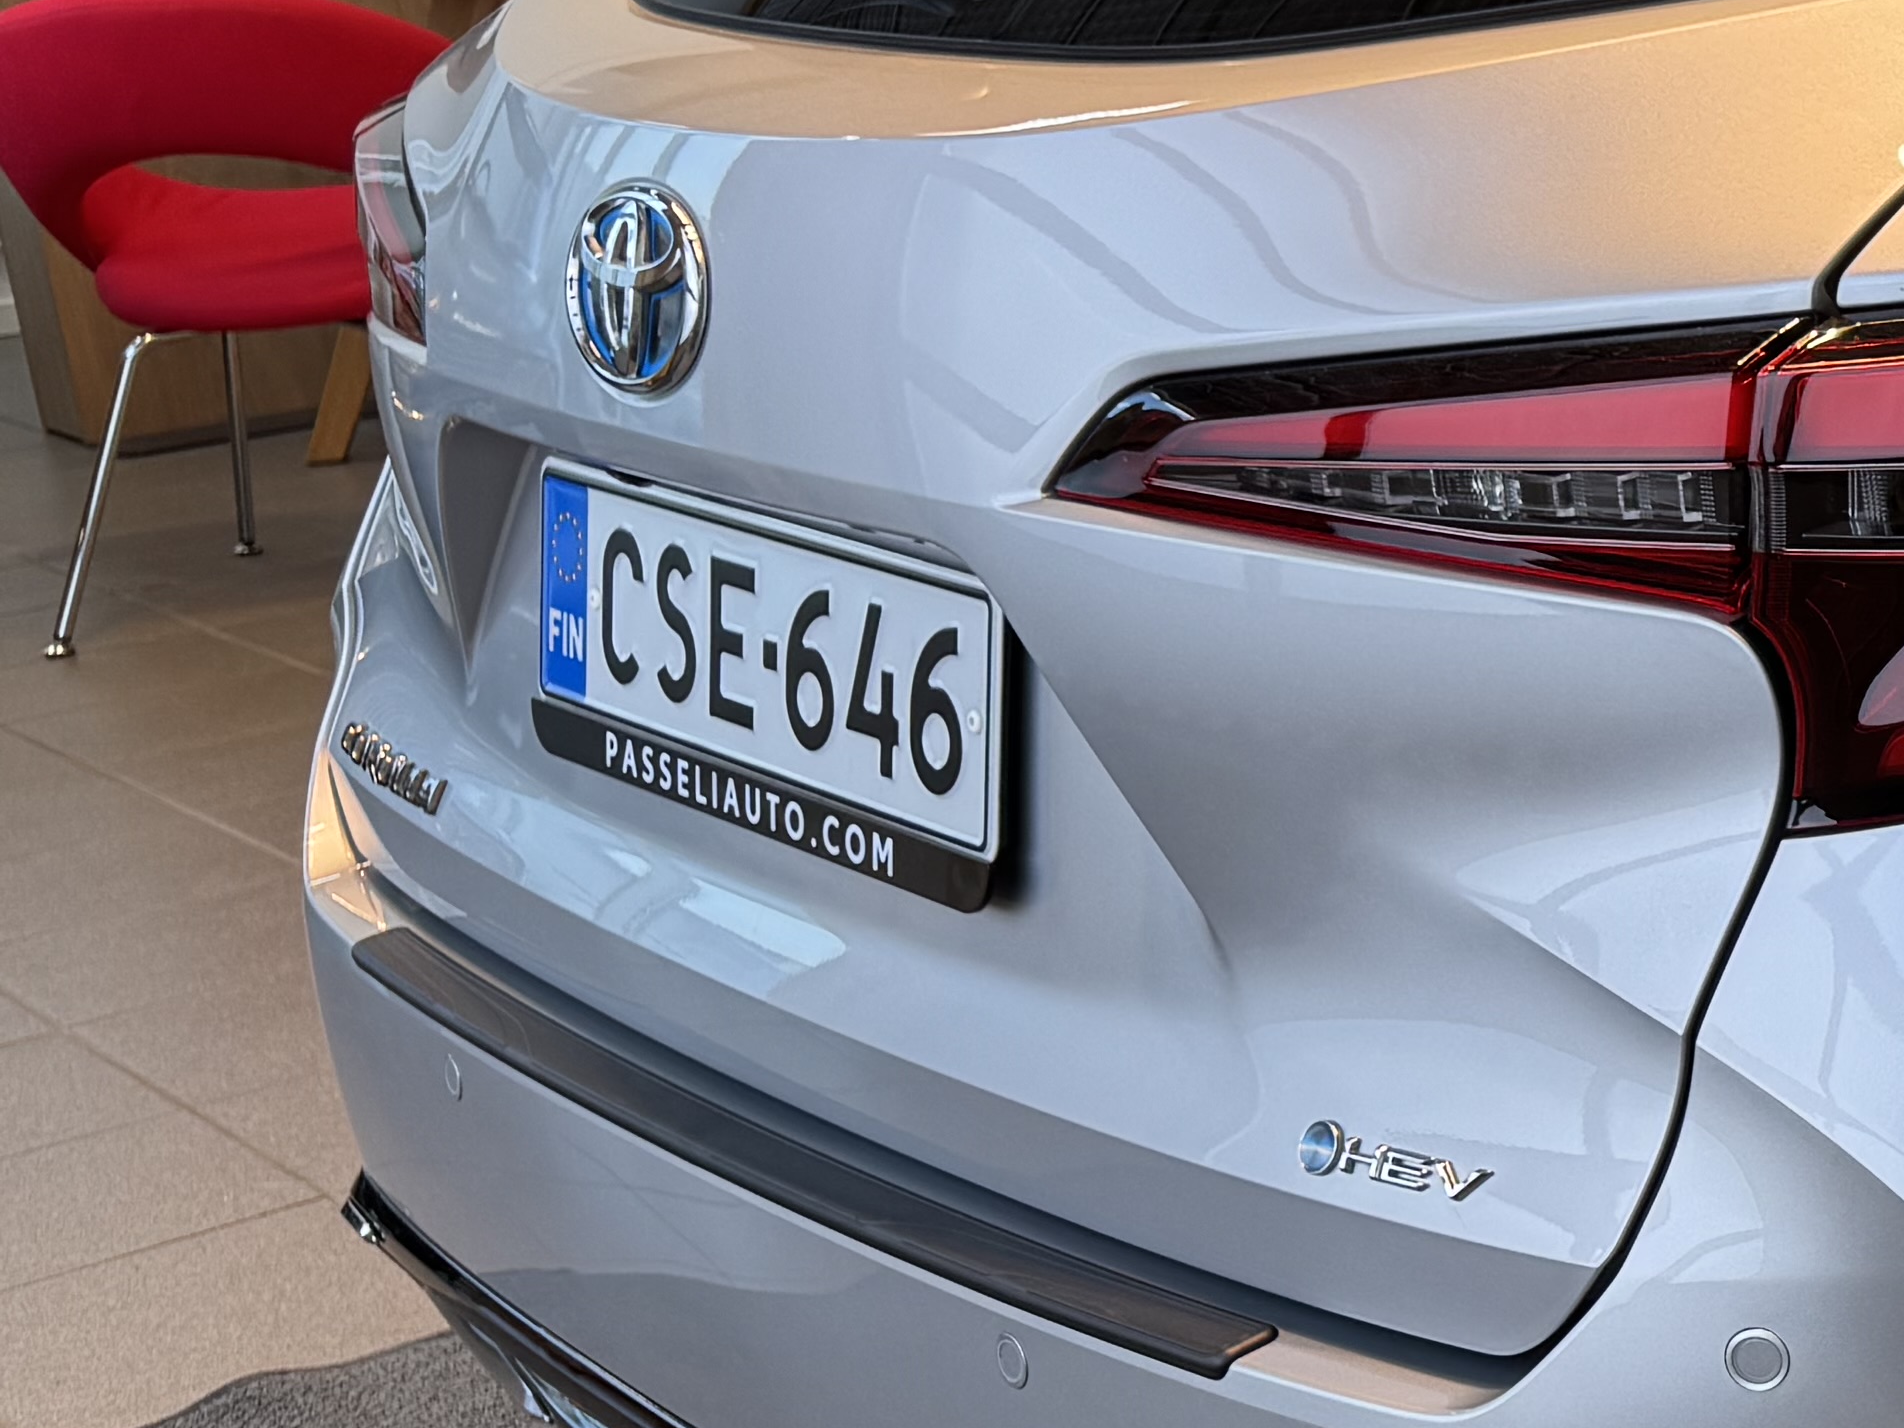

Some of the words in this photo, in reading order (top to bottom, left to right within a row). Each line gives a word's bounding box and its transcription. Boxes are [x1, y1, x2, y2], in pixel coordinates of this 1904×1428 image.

[549, 606, 584, 662] FIN
[602, 526, 963, 796] CSE-646
[604, 730, 895, 878] PASSELIAUTO.COM
